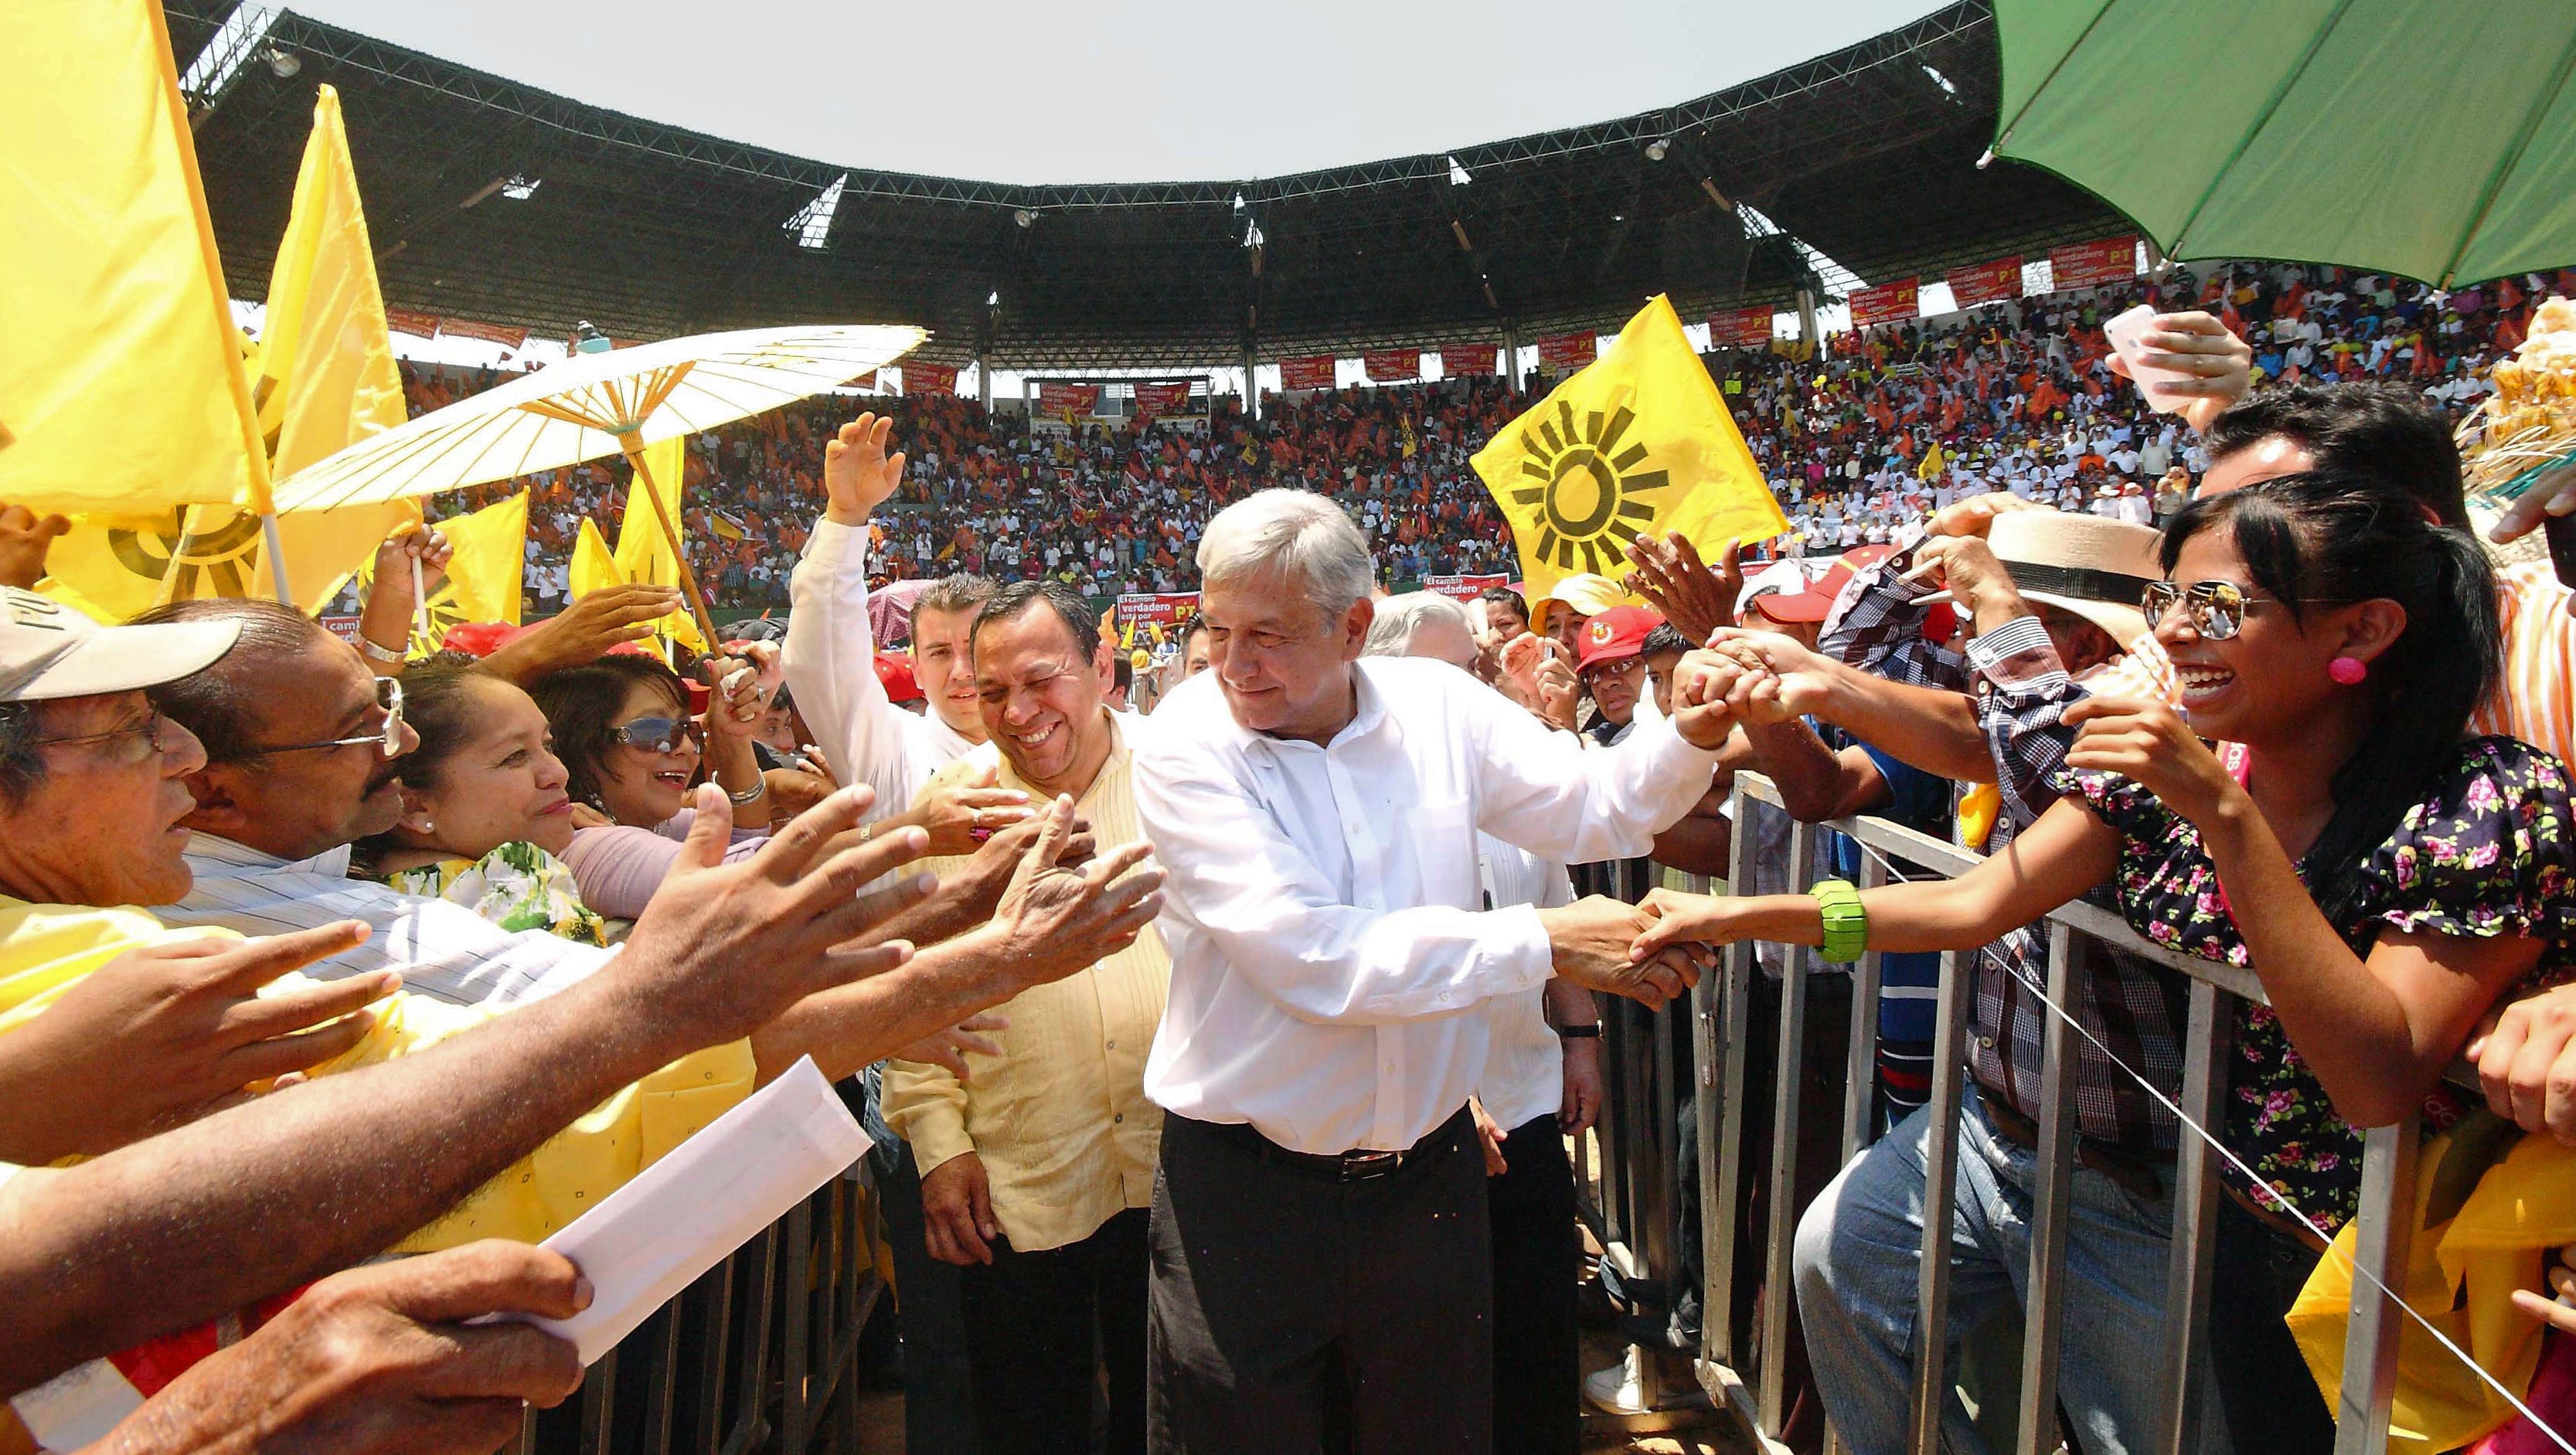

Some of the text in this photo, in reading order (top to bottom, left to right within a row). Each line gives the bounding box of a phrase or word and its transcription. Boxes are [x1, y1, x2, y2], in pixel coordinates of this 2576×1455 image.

[2055, 250, 2105, 263] verdadero
[2110, 248, 2131, 263] PT
[1999, 267, 2016, 283] PT
[1853, 290, 1893, 302] verdadero
[1897, 288, 1914, 302] PT
[1753, 316, 1769, 328] PT
[1579, 338, 1593, 351] PT
[1404, 358, 1417, 367] PT
[1480, 352, 1492, 362] PT
[1319, 364, 1332, 374] PT
[941, 374, 955, 386] PT
[1043, 390, 1078, 399] verdadero
[1175, 391, 1189, 408] PT
[1128, 595, 1156, 603] cambio
[1121, 603, 1172, 613] verdadero
[1176, 605, 1196, 619] PT
[1138, 613, 1152, 621] por
